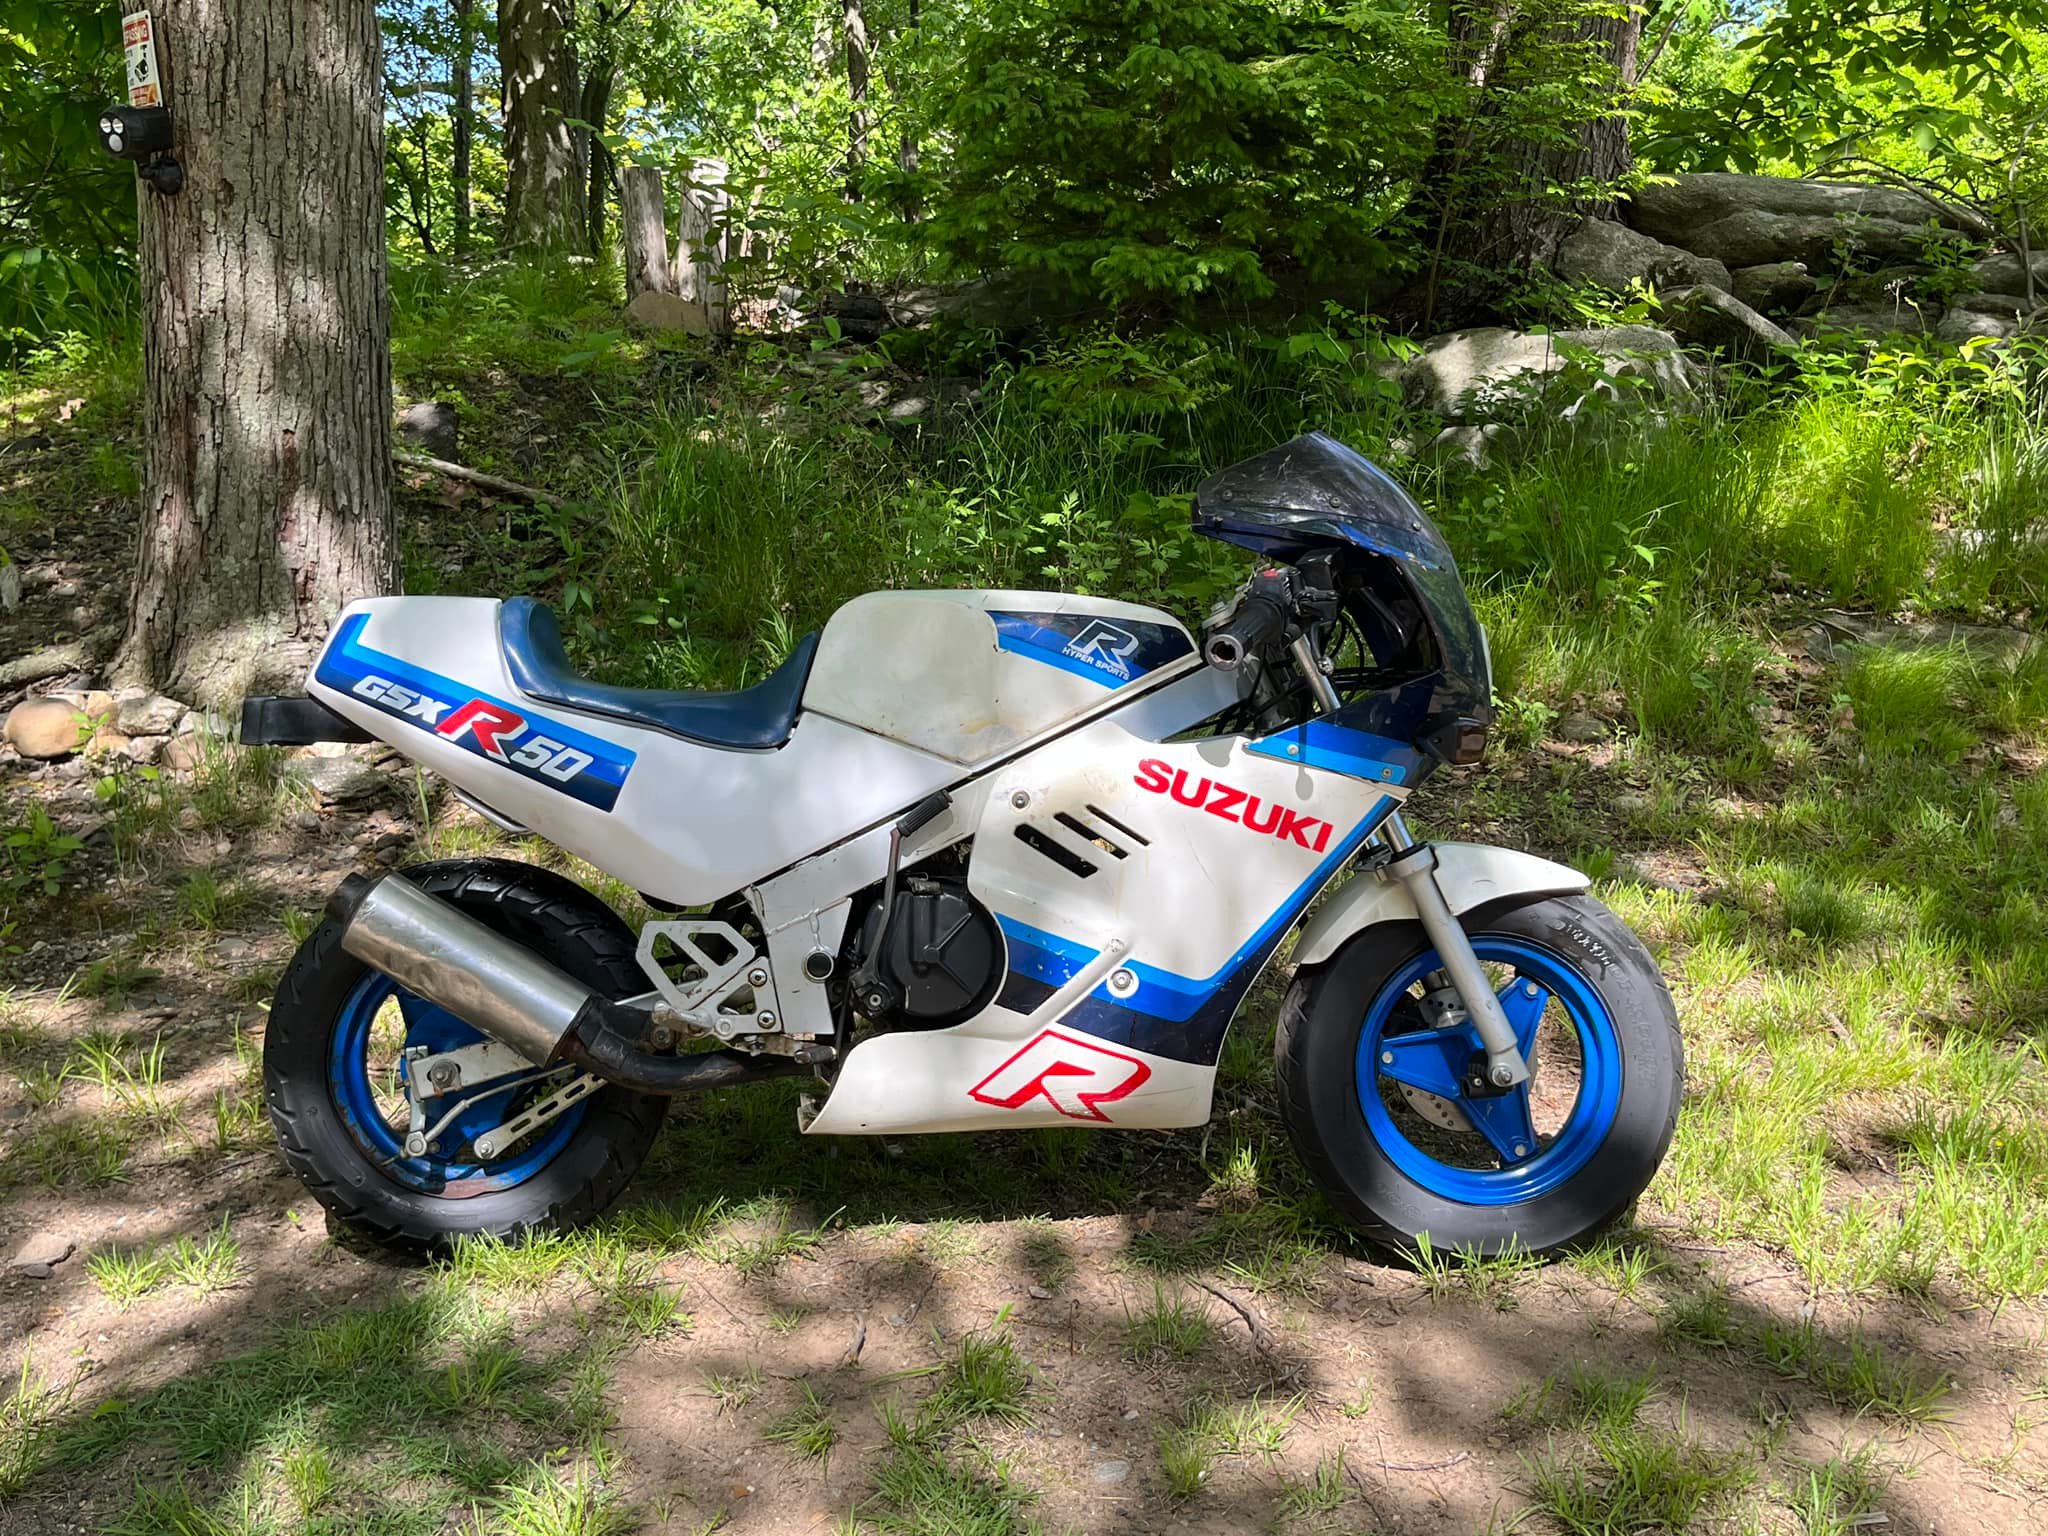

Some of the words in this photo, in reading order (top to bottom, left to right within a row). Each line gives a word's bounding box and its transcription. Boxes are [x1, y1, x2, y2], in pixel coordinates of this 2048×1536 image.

[1062, 647, 1094, 665] HYPER
[1095, 659, 1130, 681] SPORTS
[1068, 619, 1139, 673] R
[352, 675, 452, 724] GSX
[510, 737, 594, 782] 50
[1133, 758, 1334, 853] SUZUKI
[967, 1029, 1152, 1123] R
